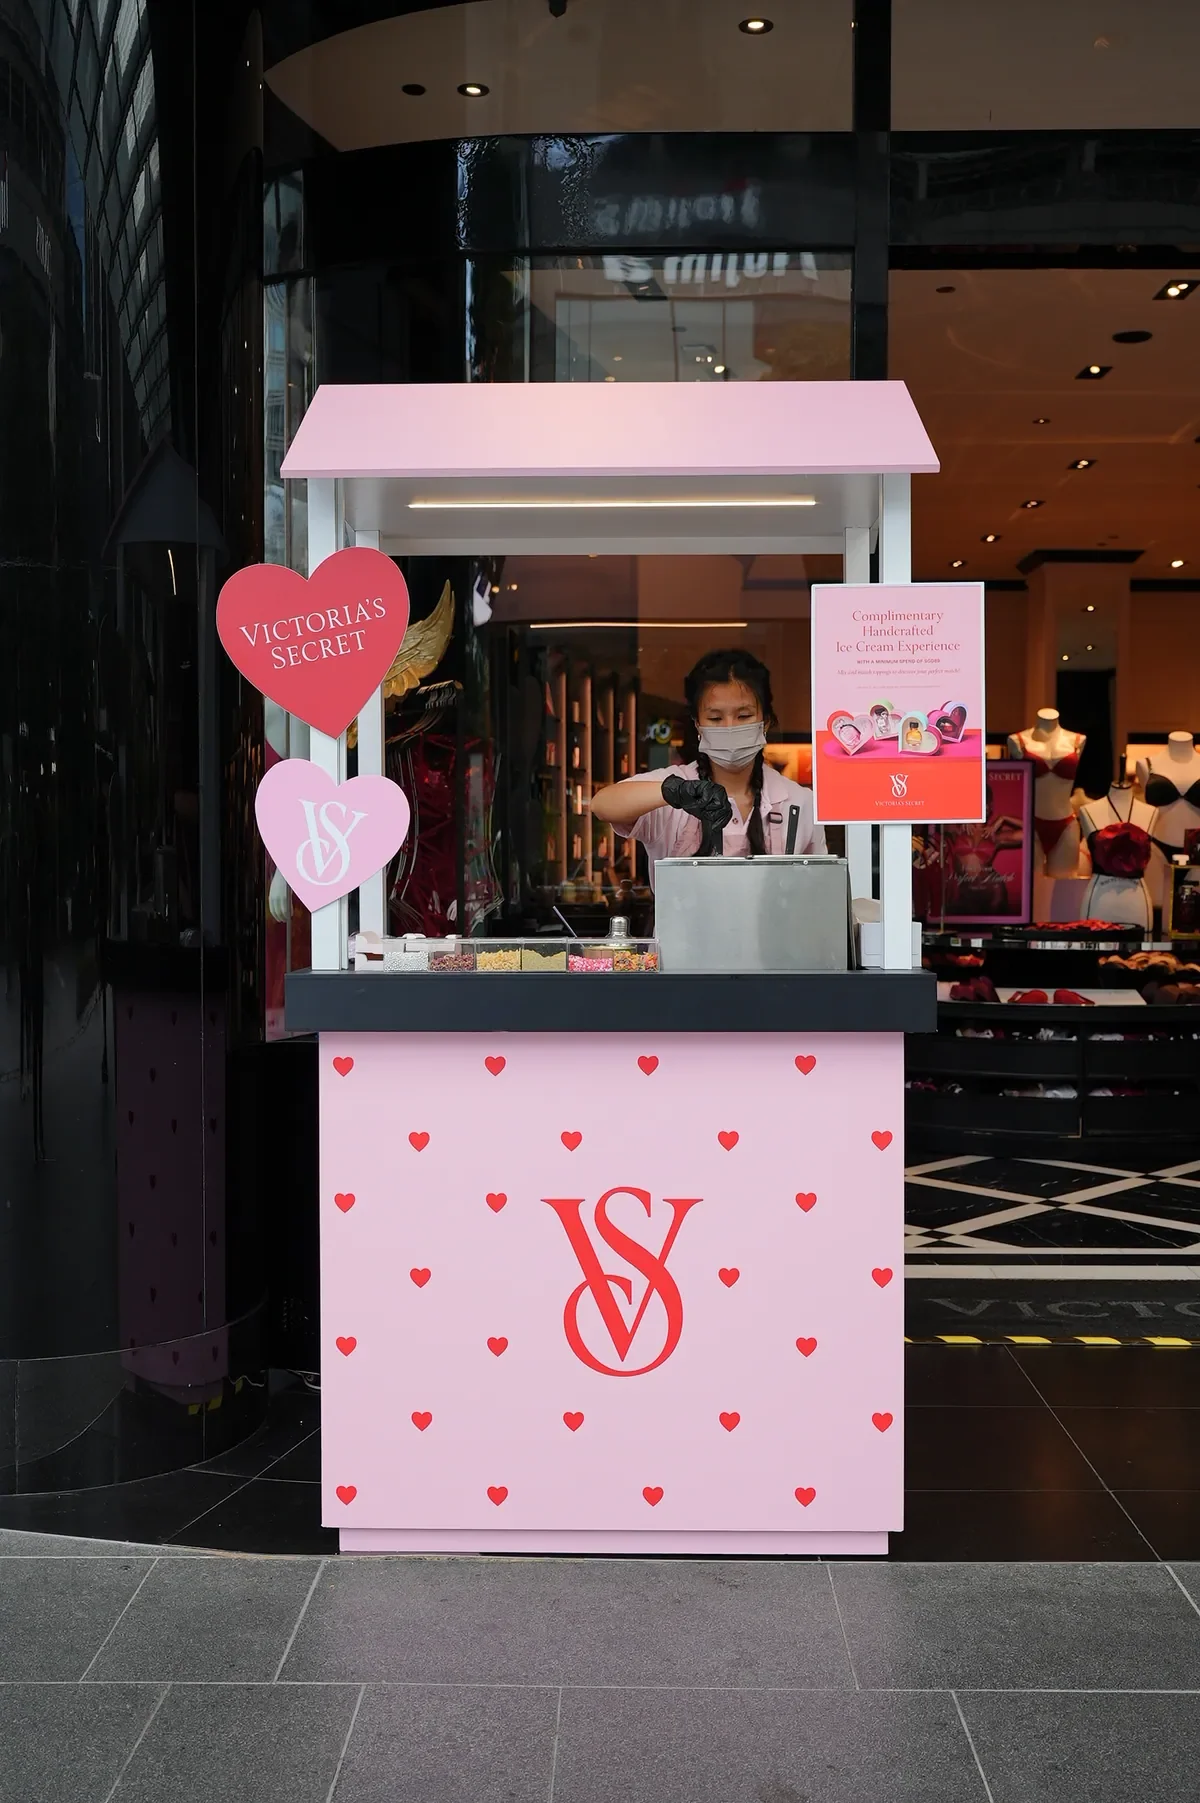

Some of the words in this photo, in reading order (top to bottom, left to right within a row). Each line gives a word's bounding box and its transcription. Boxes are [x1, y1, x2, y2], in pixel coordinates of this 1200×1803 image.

[239, 597, 387, 647] VICTORIA'S
[852, 610, 944, 624] Complimentary
[862, 625, 934, 637] Handcrafted
[271, 629, 366, 670] SECRET
[836, 641, 852, 653] Ice
[856, 640, 894, 653] Cream
[898, 640, 961, 655] Experience
[989, 772, 1022, 782] SECRET
